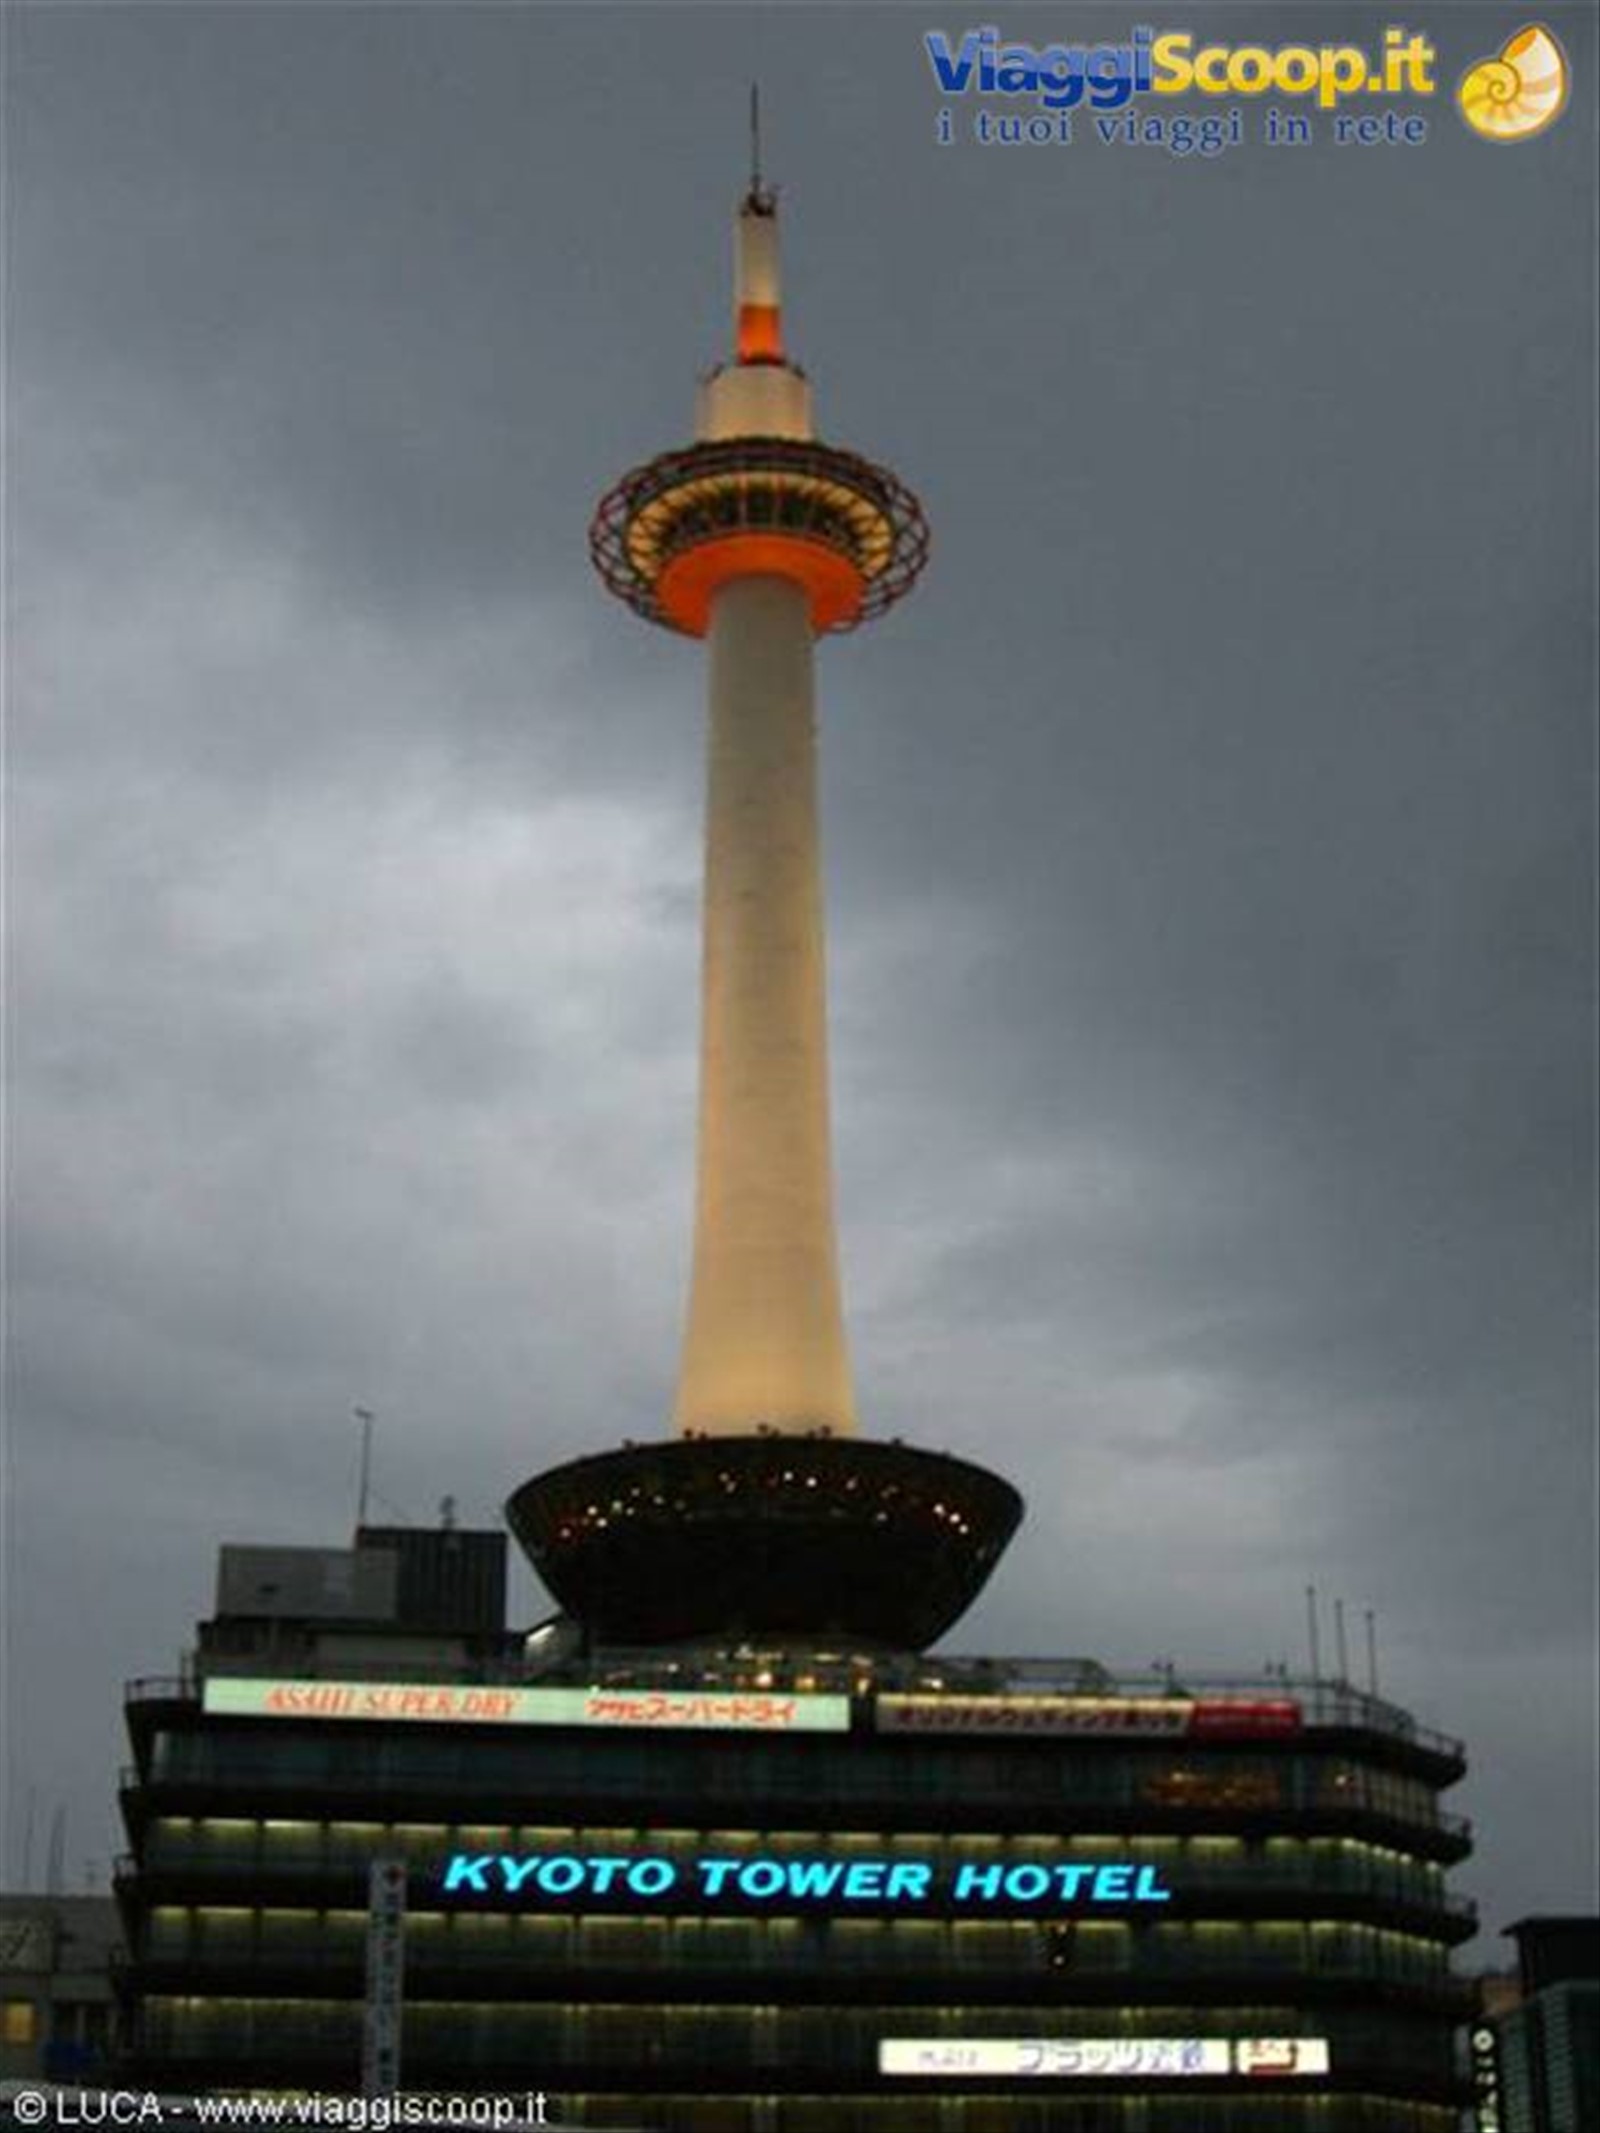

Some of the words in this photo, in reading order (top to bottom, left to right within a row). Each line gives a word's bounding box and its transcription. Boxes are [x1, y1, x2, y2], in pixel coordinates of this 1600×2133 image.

[365, 1690, 455, 1716] SUPER
[443, 1855, 675, 1894] KYOTO
[699, 1861, 932, 1900] TOWER
[953, 1864, 1172, 1902] HOTEL
